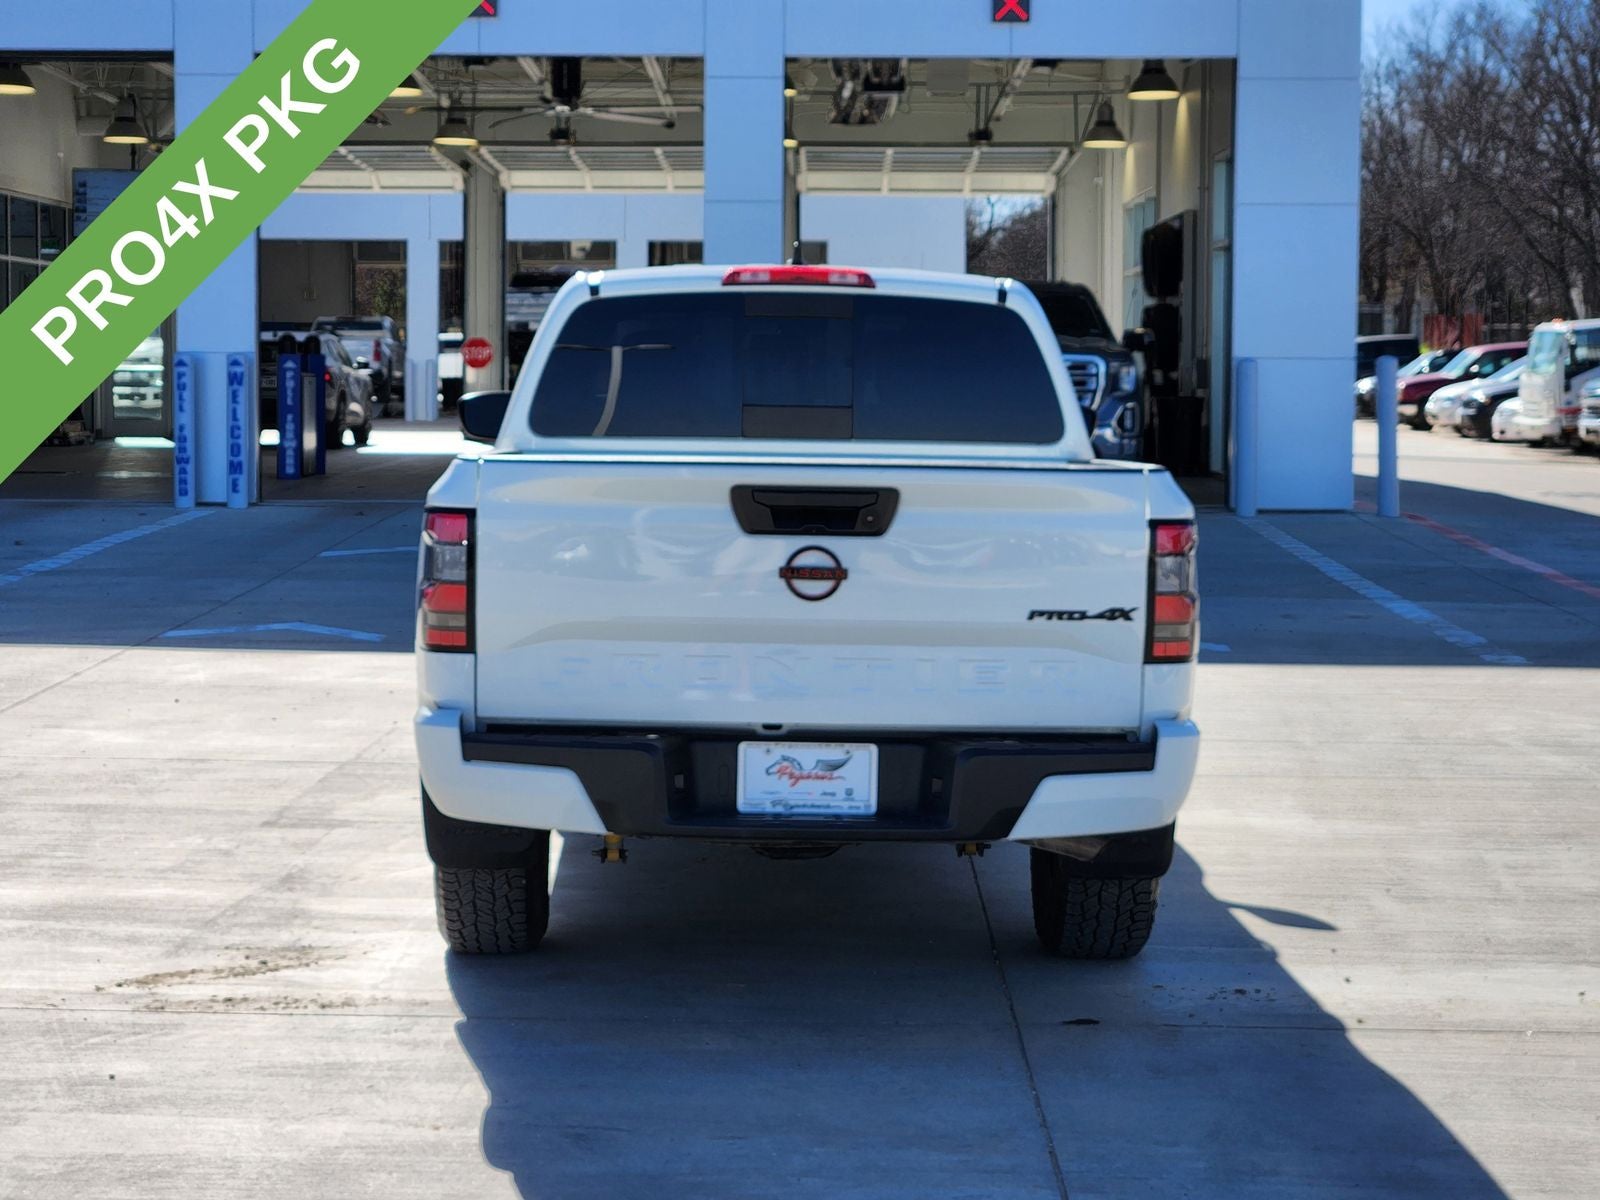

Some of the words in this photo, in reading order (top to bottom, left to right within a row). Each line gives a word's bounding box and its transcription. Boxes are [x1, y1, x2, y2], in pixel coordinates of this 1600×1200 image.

[463, 346, 492, 360] STOP
[176, 371, 187, 412] PULL
[228, 371, 244, 494] WELCOME
[781, 568, 846, 578] NISSAN
